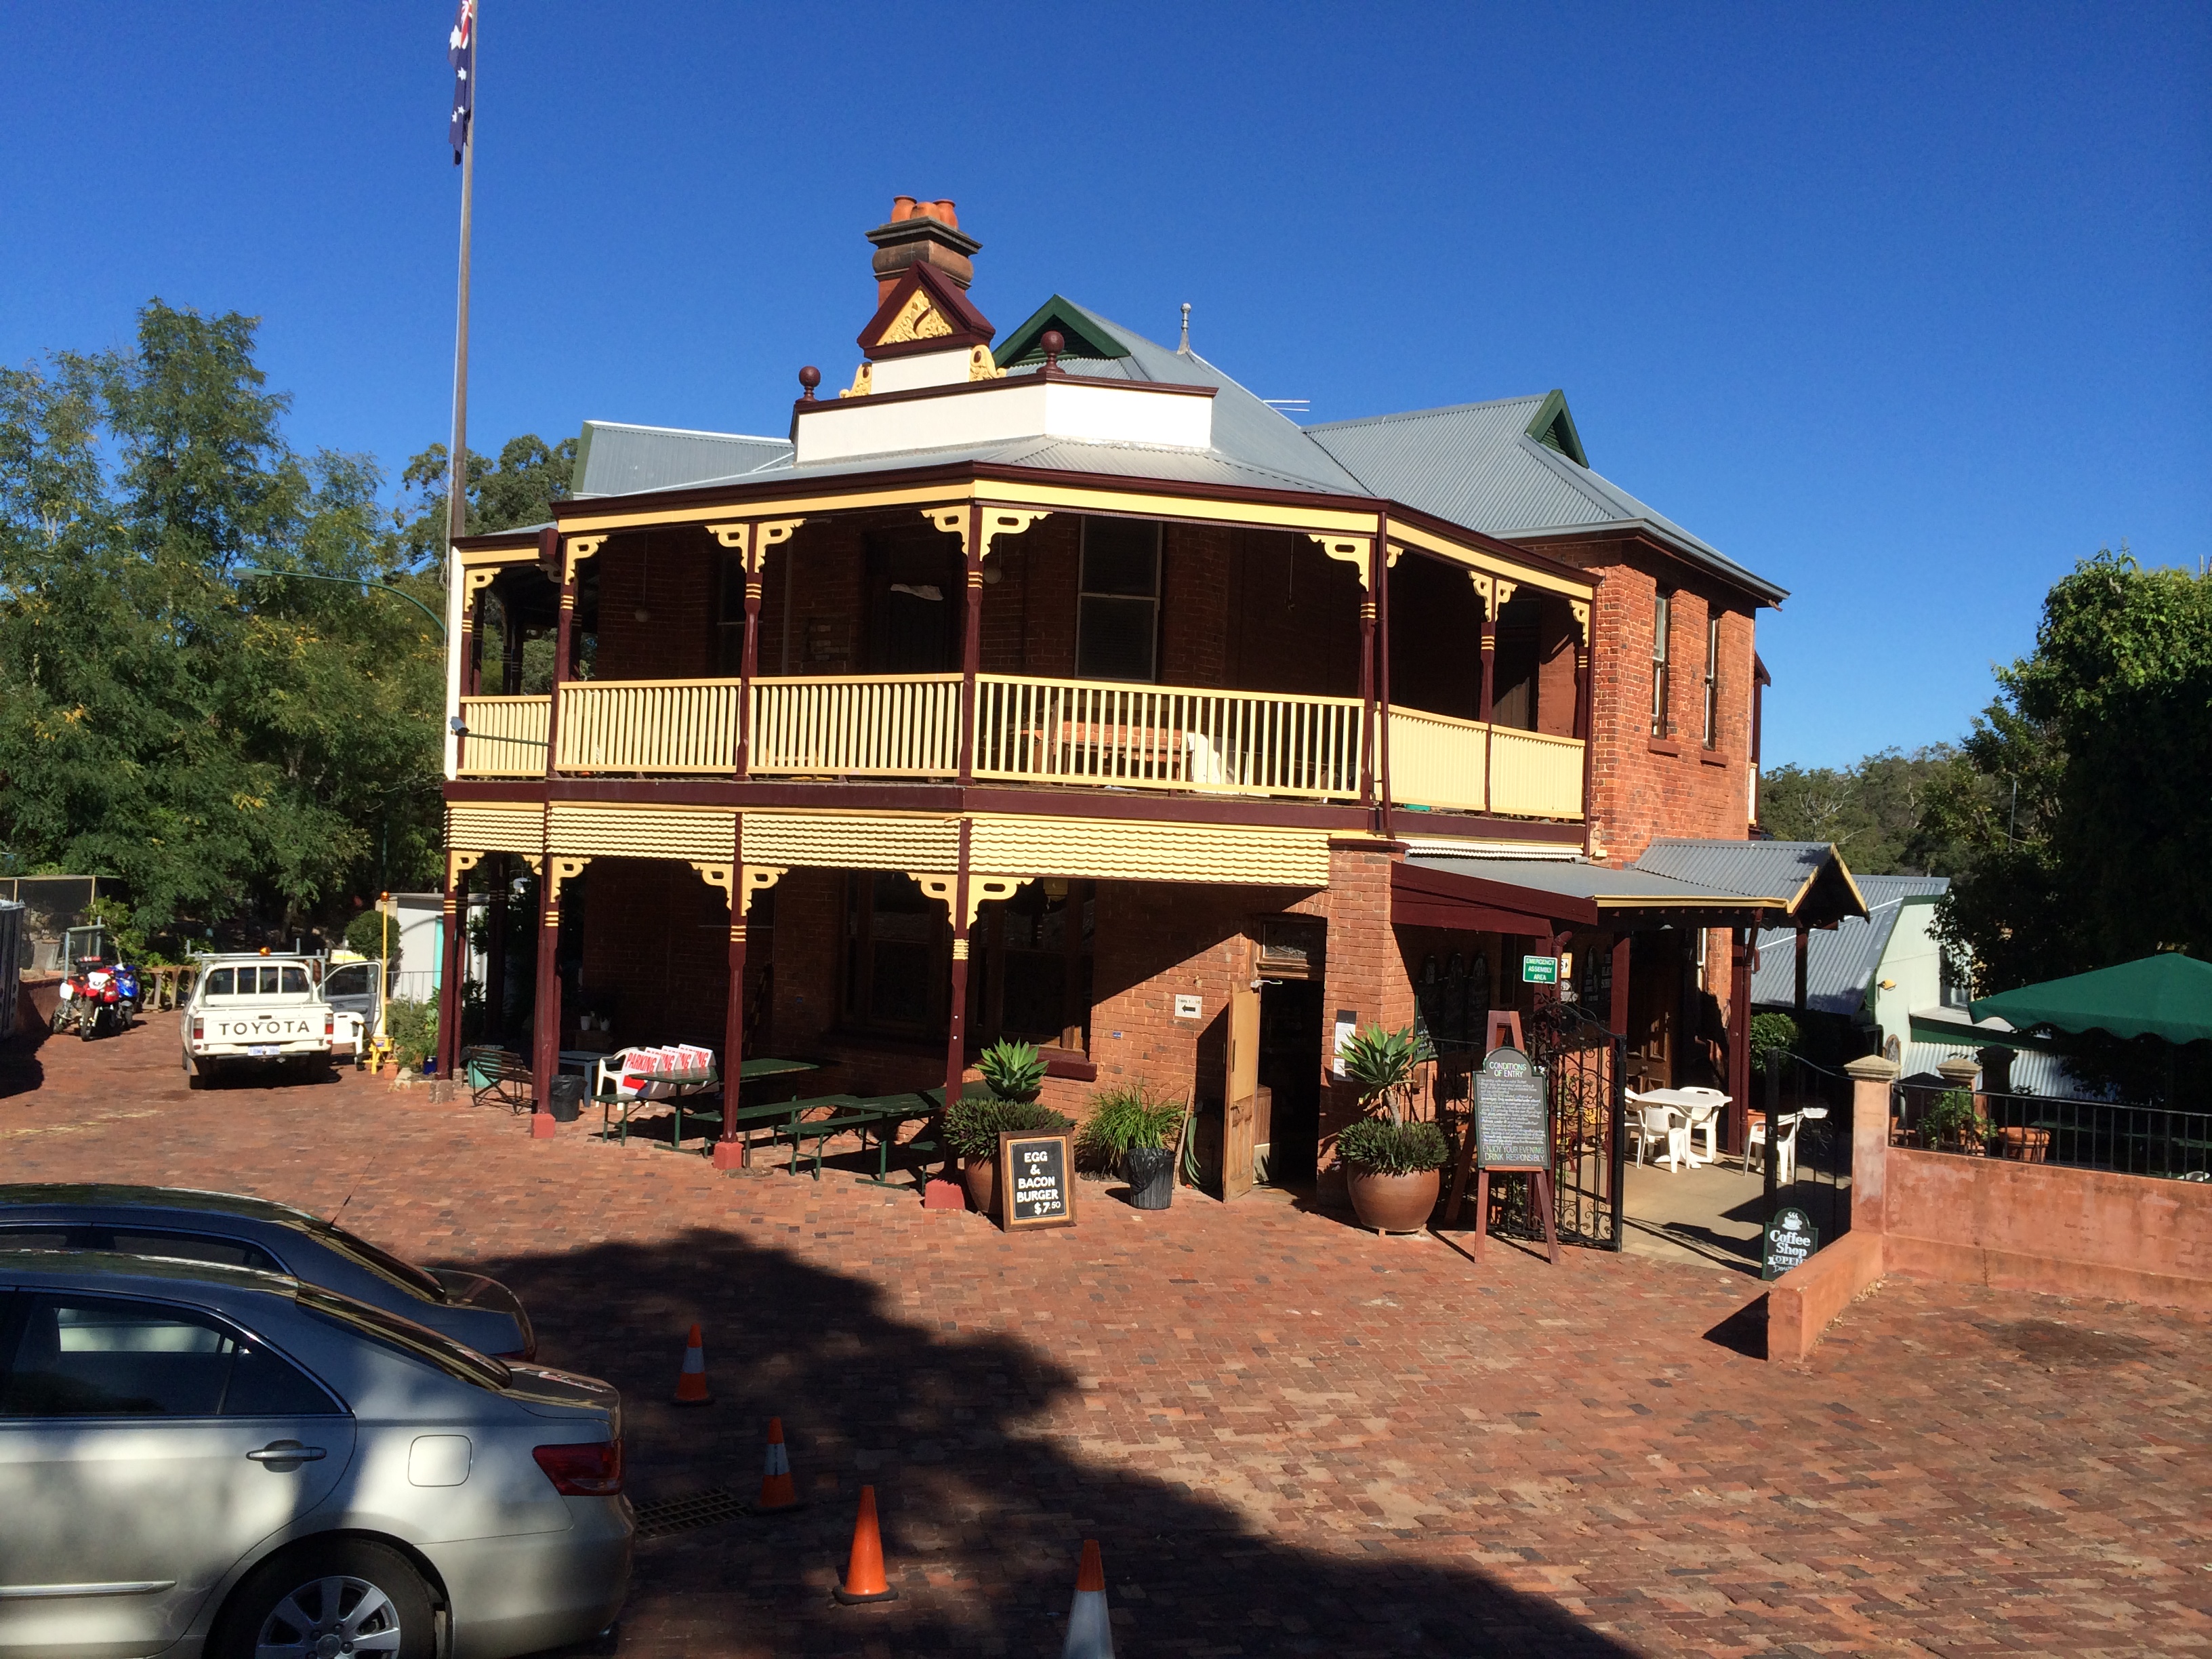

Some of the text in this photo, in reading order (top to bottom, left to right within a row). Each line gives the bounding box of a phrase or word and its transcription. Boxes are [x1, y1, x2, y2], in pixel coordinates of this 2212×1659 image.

[1526, 958, 1555, 966] EMERGENCY
[218, 1021, 310, 1036] TOYOTA
[624, 1052, 657, 1073] PARKING
[1489, 1061, 1527, 1071] CONDITIONS
[1482, 1145, 1544, 1154] ENJOY YOUR EVENING
[1024, 1151, 1048, 1163] EGG
[1485, 1153, 1504, 1161] DRINK
[1030, 1164, 1041, 1175] &
[1018, 1176, 1055, 1189] BACON
[1017, 1189, 1059, 1203] BURGER
[1769, 1229, 1811, 1246] Coffee
[1776, 1242, 1807, 1258] Shop
[1775, 1256, 1803, 1265] OPEN
